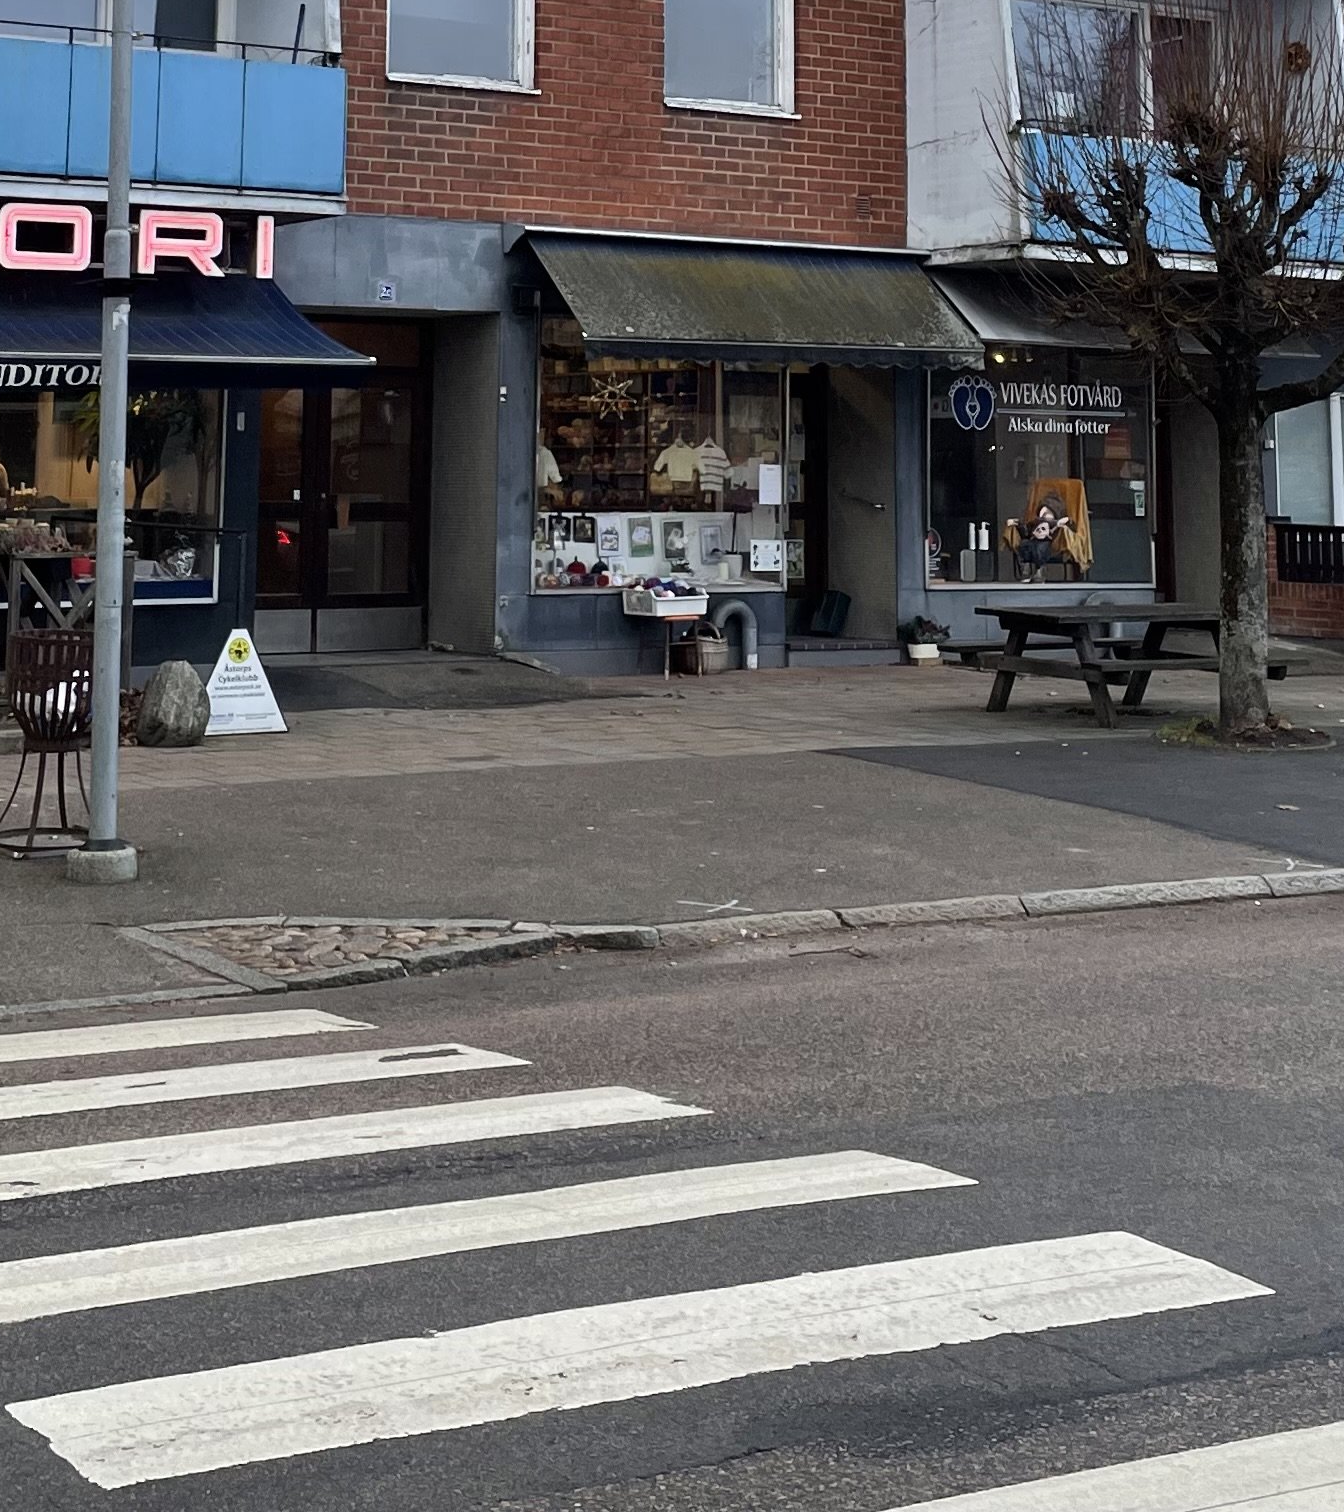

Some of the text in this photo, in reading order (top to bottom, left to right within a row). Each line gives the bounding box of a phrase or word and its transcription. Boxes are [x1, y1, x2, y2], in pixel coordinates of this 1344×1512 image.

[999, 379, 1122, 408] VIVEKAS FOTVÅRD
[1008, 416, 1111, 437] Älska dina fötter
